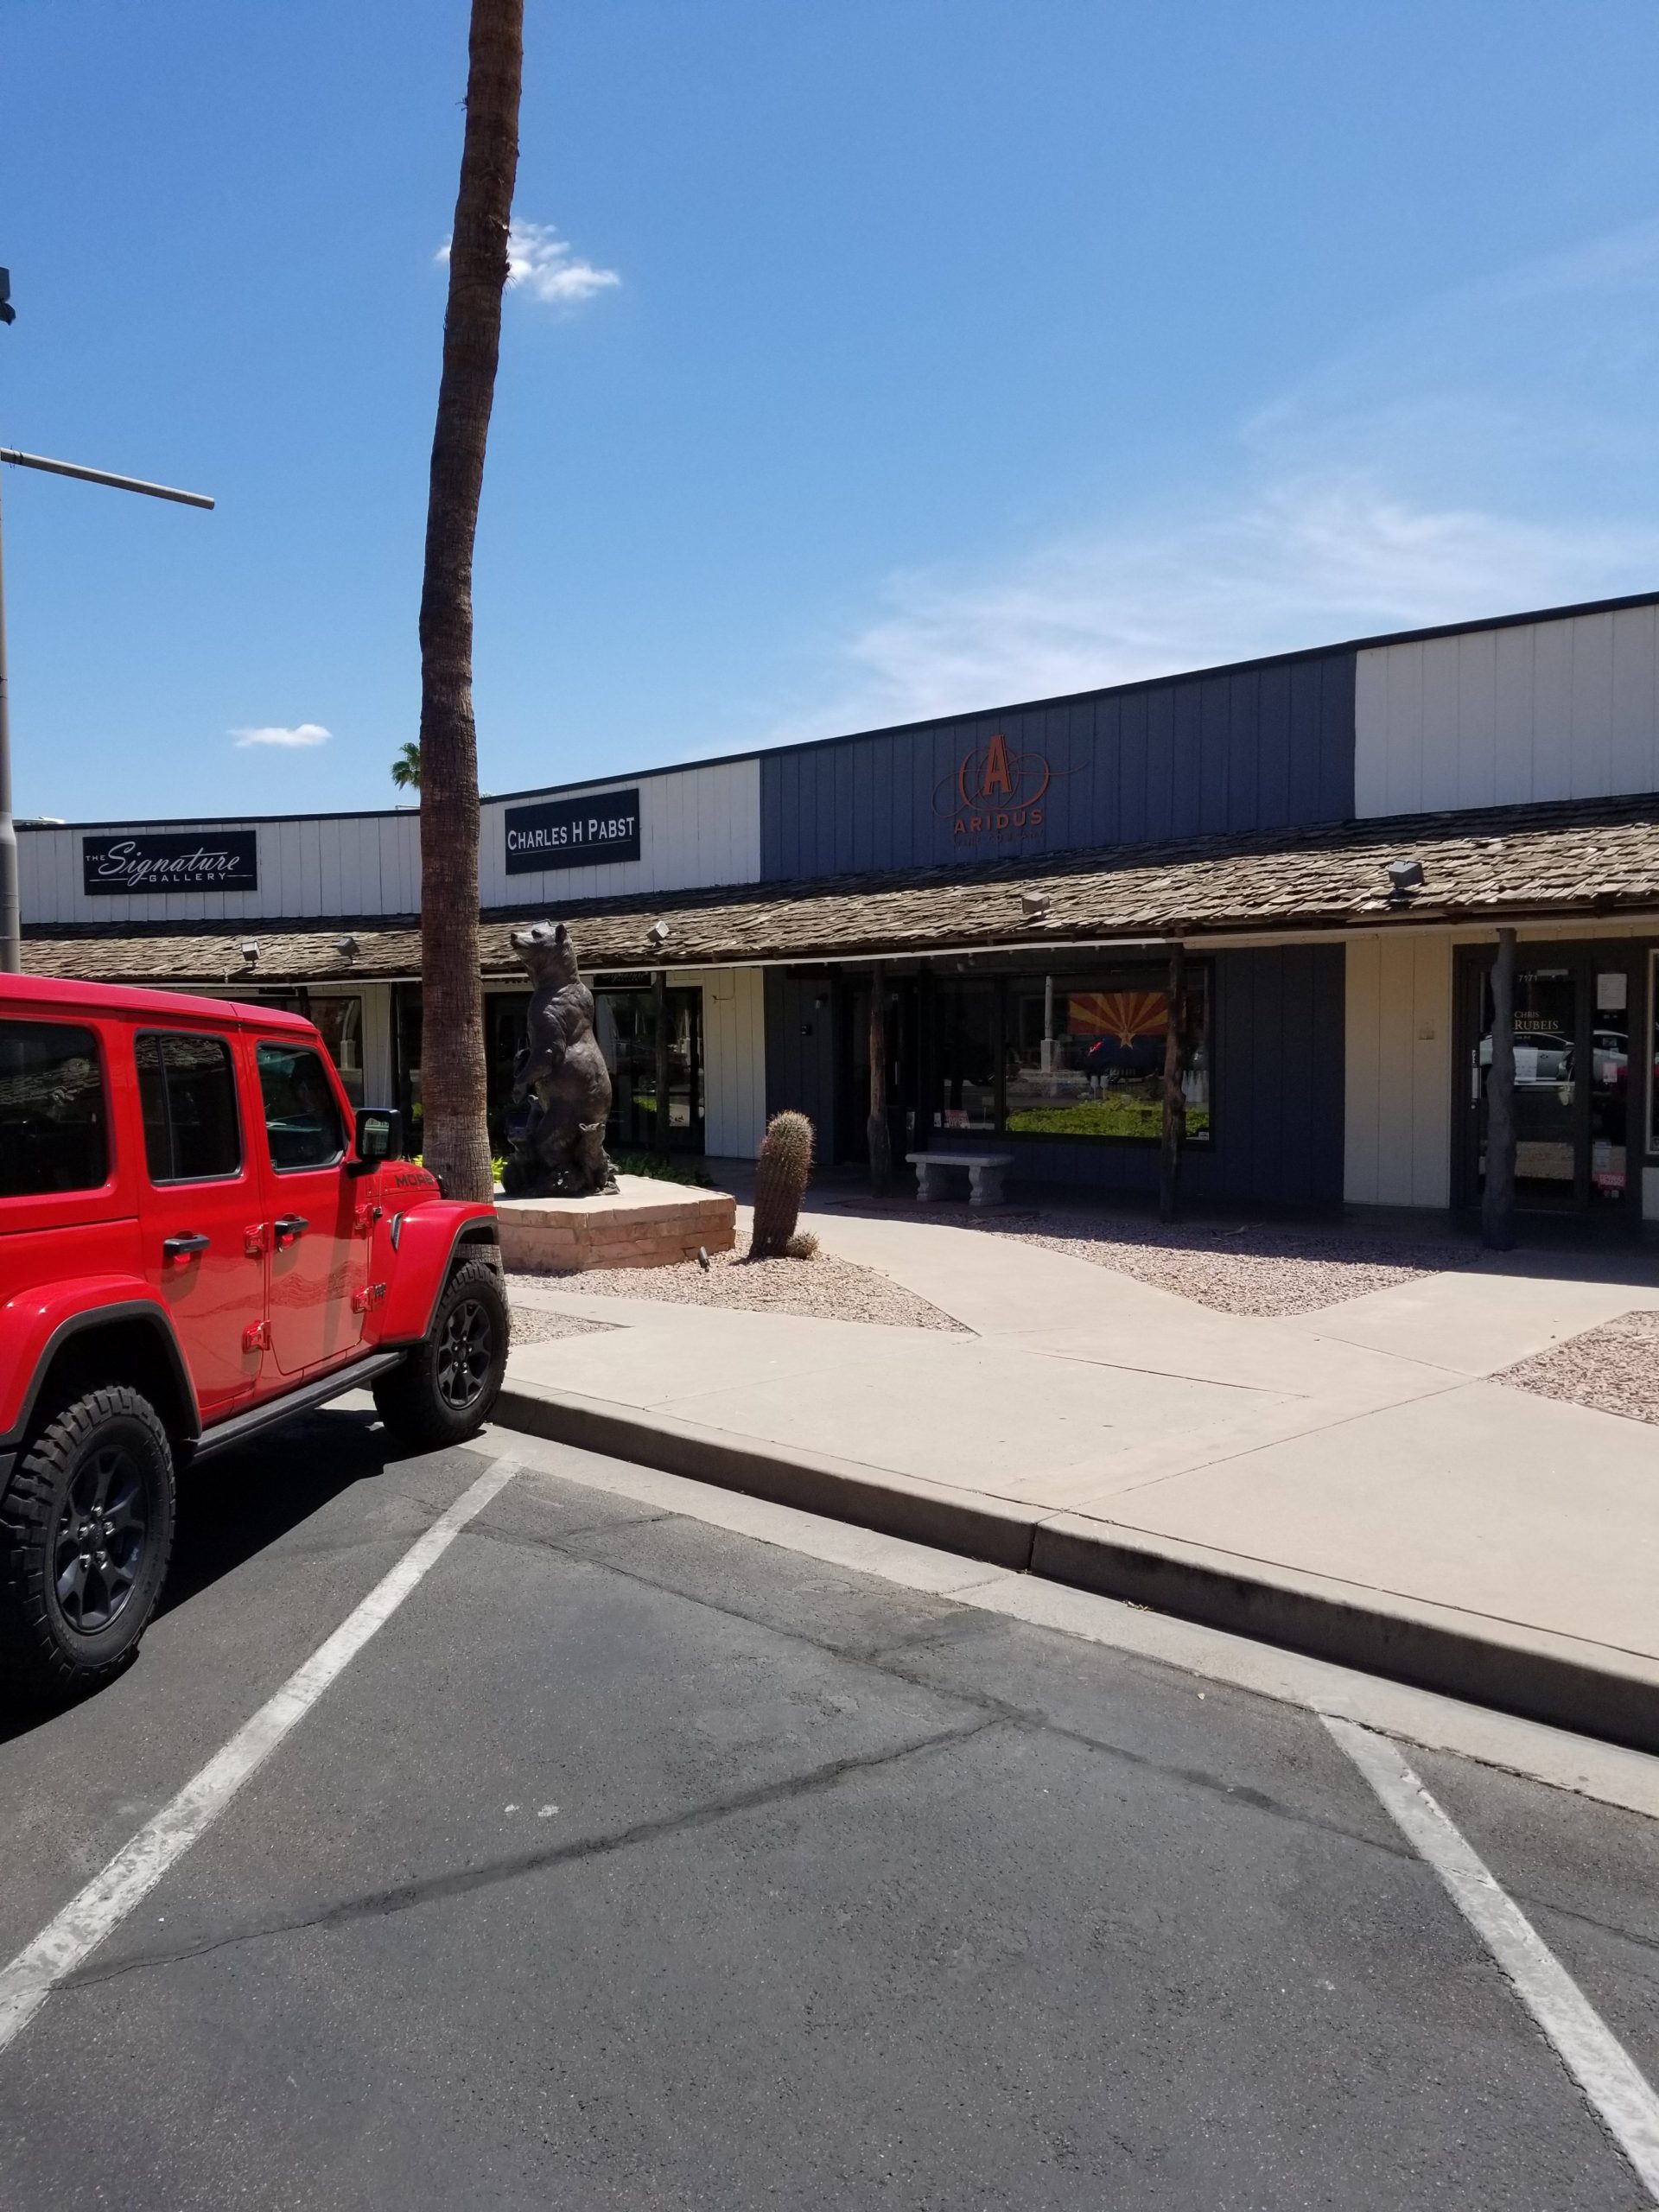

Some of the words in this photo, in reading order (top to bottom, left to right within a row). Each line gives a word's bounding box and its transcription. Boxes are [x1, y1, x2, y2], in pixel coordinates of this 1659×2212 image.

[982, 734, 1013, 796] A
[507, 826, 568, 850] CHARLES
[572, 821, 582, 842] H
[588, 817, 635, 841] PABST
[954, 809, 1043, 835] ARIDUS
[98, 841, 240, 887] Signature
[149, 872, 226, 882] GALLERY
